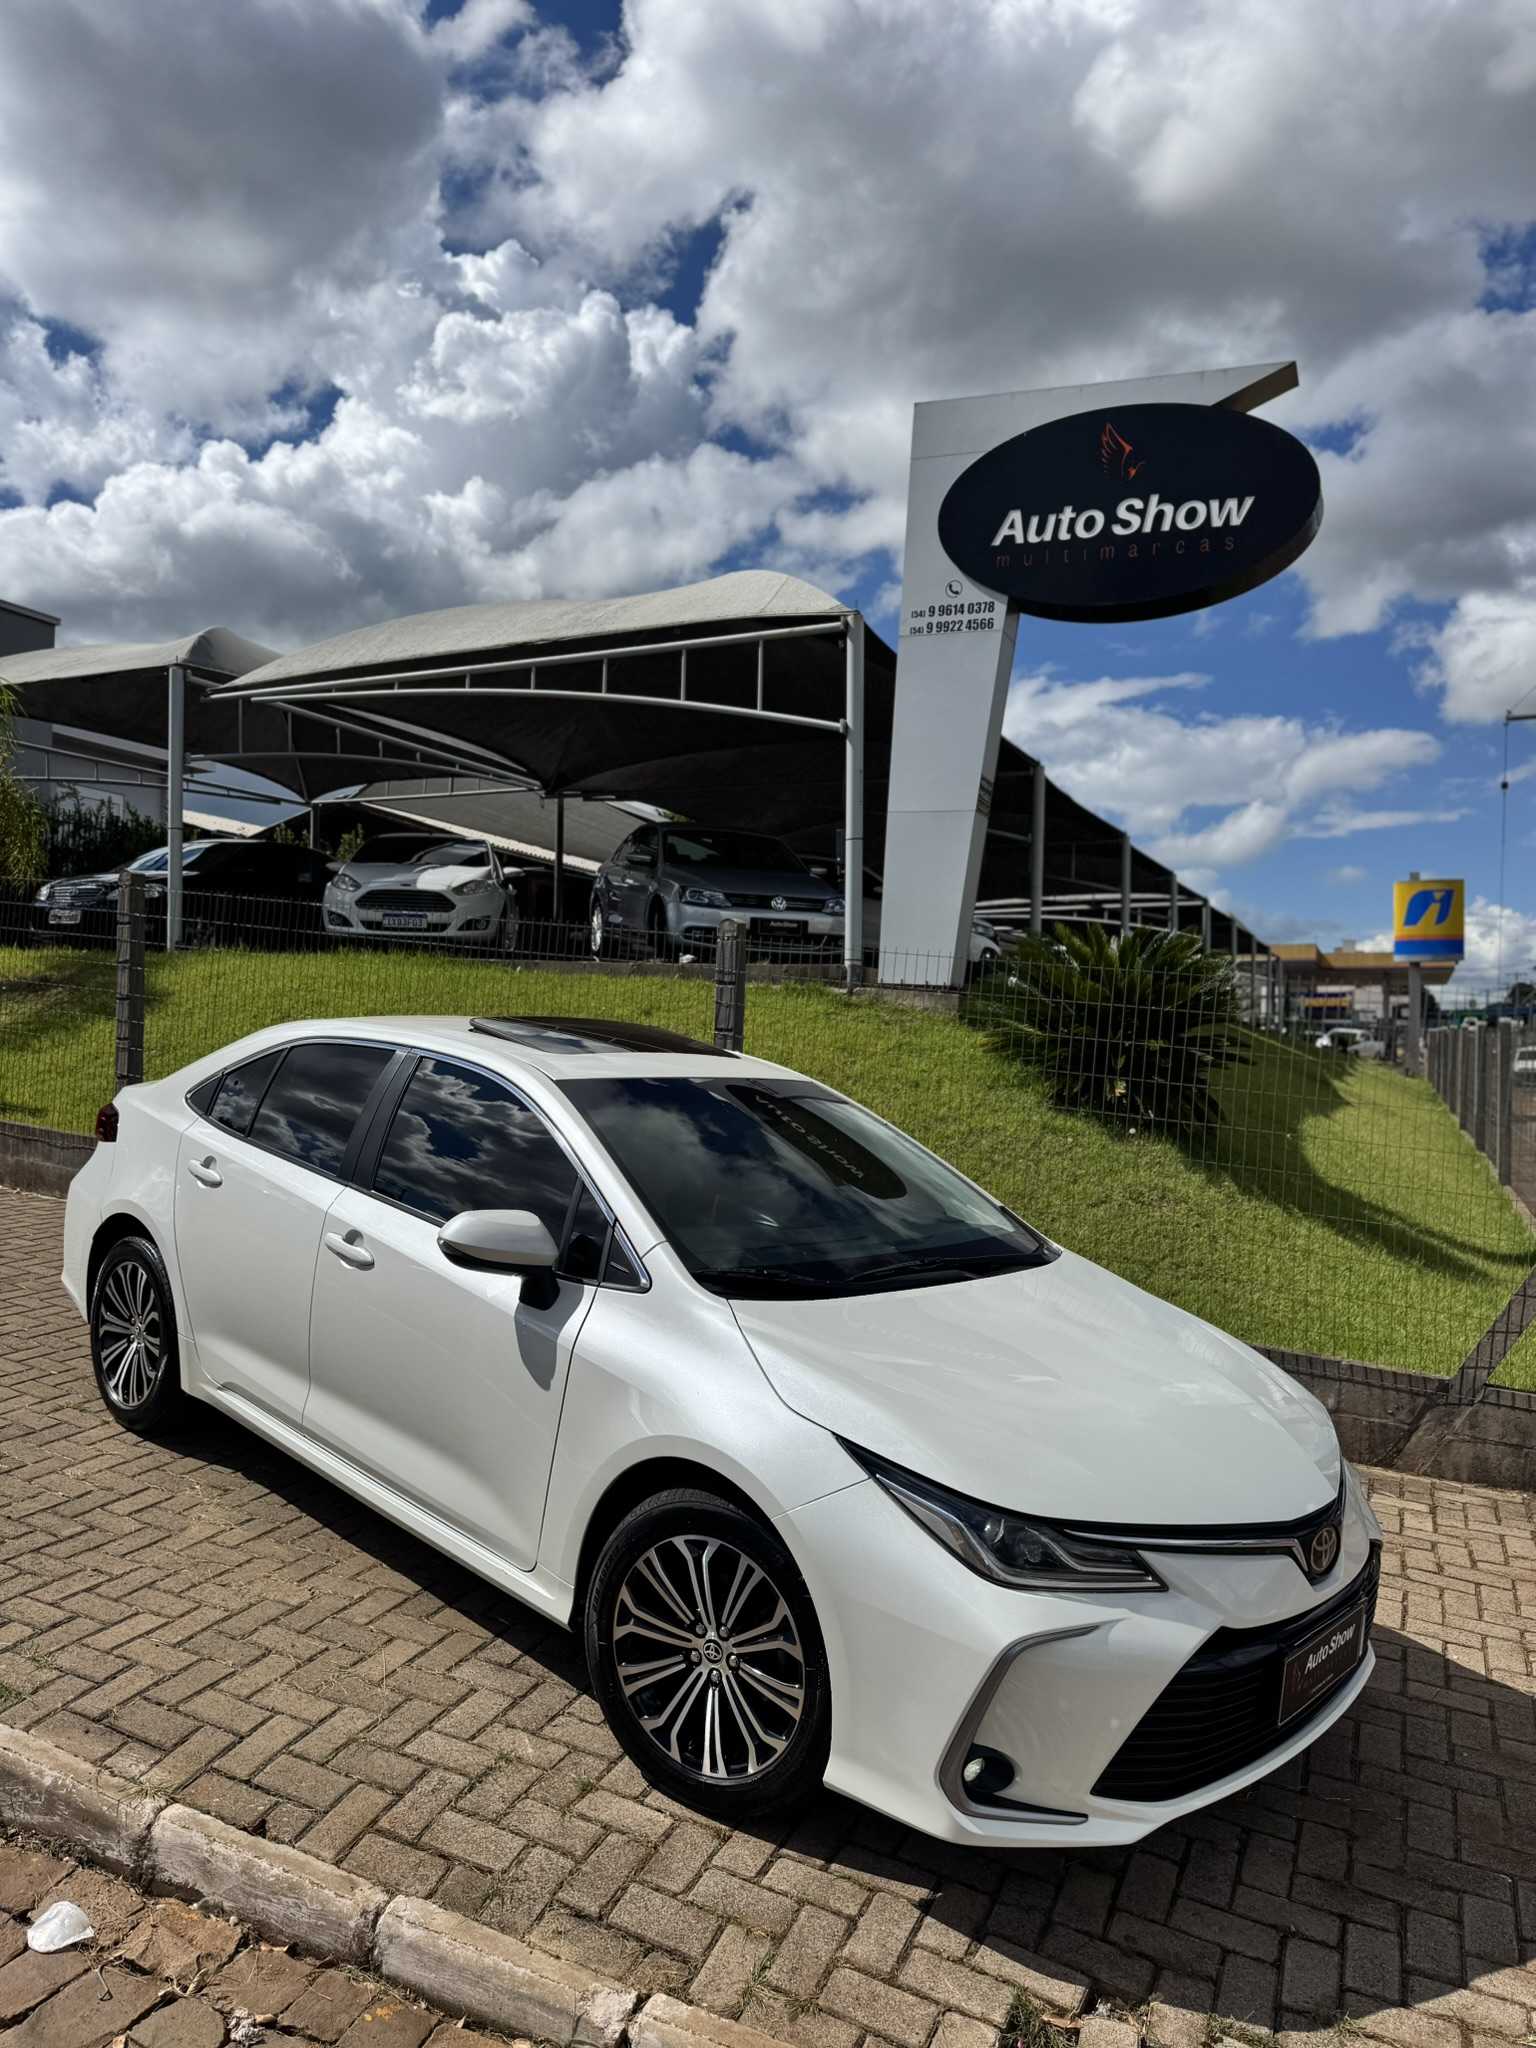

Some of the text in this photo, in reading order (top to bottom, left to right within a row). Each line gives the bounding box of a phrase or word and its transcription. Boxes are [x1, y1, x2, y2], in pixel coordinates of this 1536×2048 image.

[991, 494, 1255, 546] Auto Show
[996, 536, 1235, 569] multimarcas
[928, 605, 936, 617] 9
[938, 603, 964, 616] 9614
[967, 601, 995, 614] 0378
[926, 622, 934, 634] 9
[936, 620, 964, 633] 9922
[965, 618, 994, 631] 4566
[1305, 1623, 1356, 1675] Auto Show
